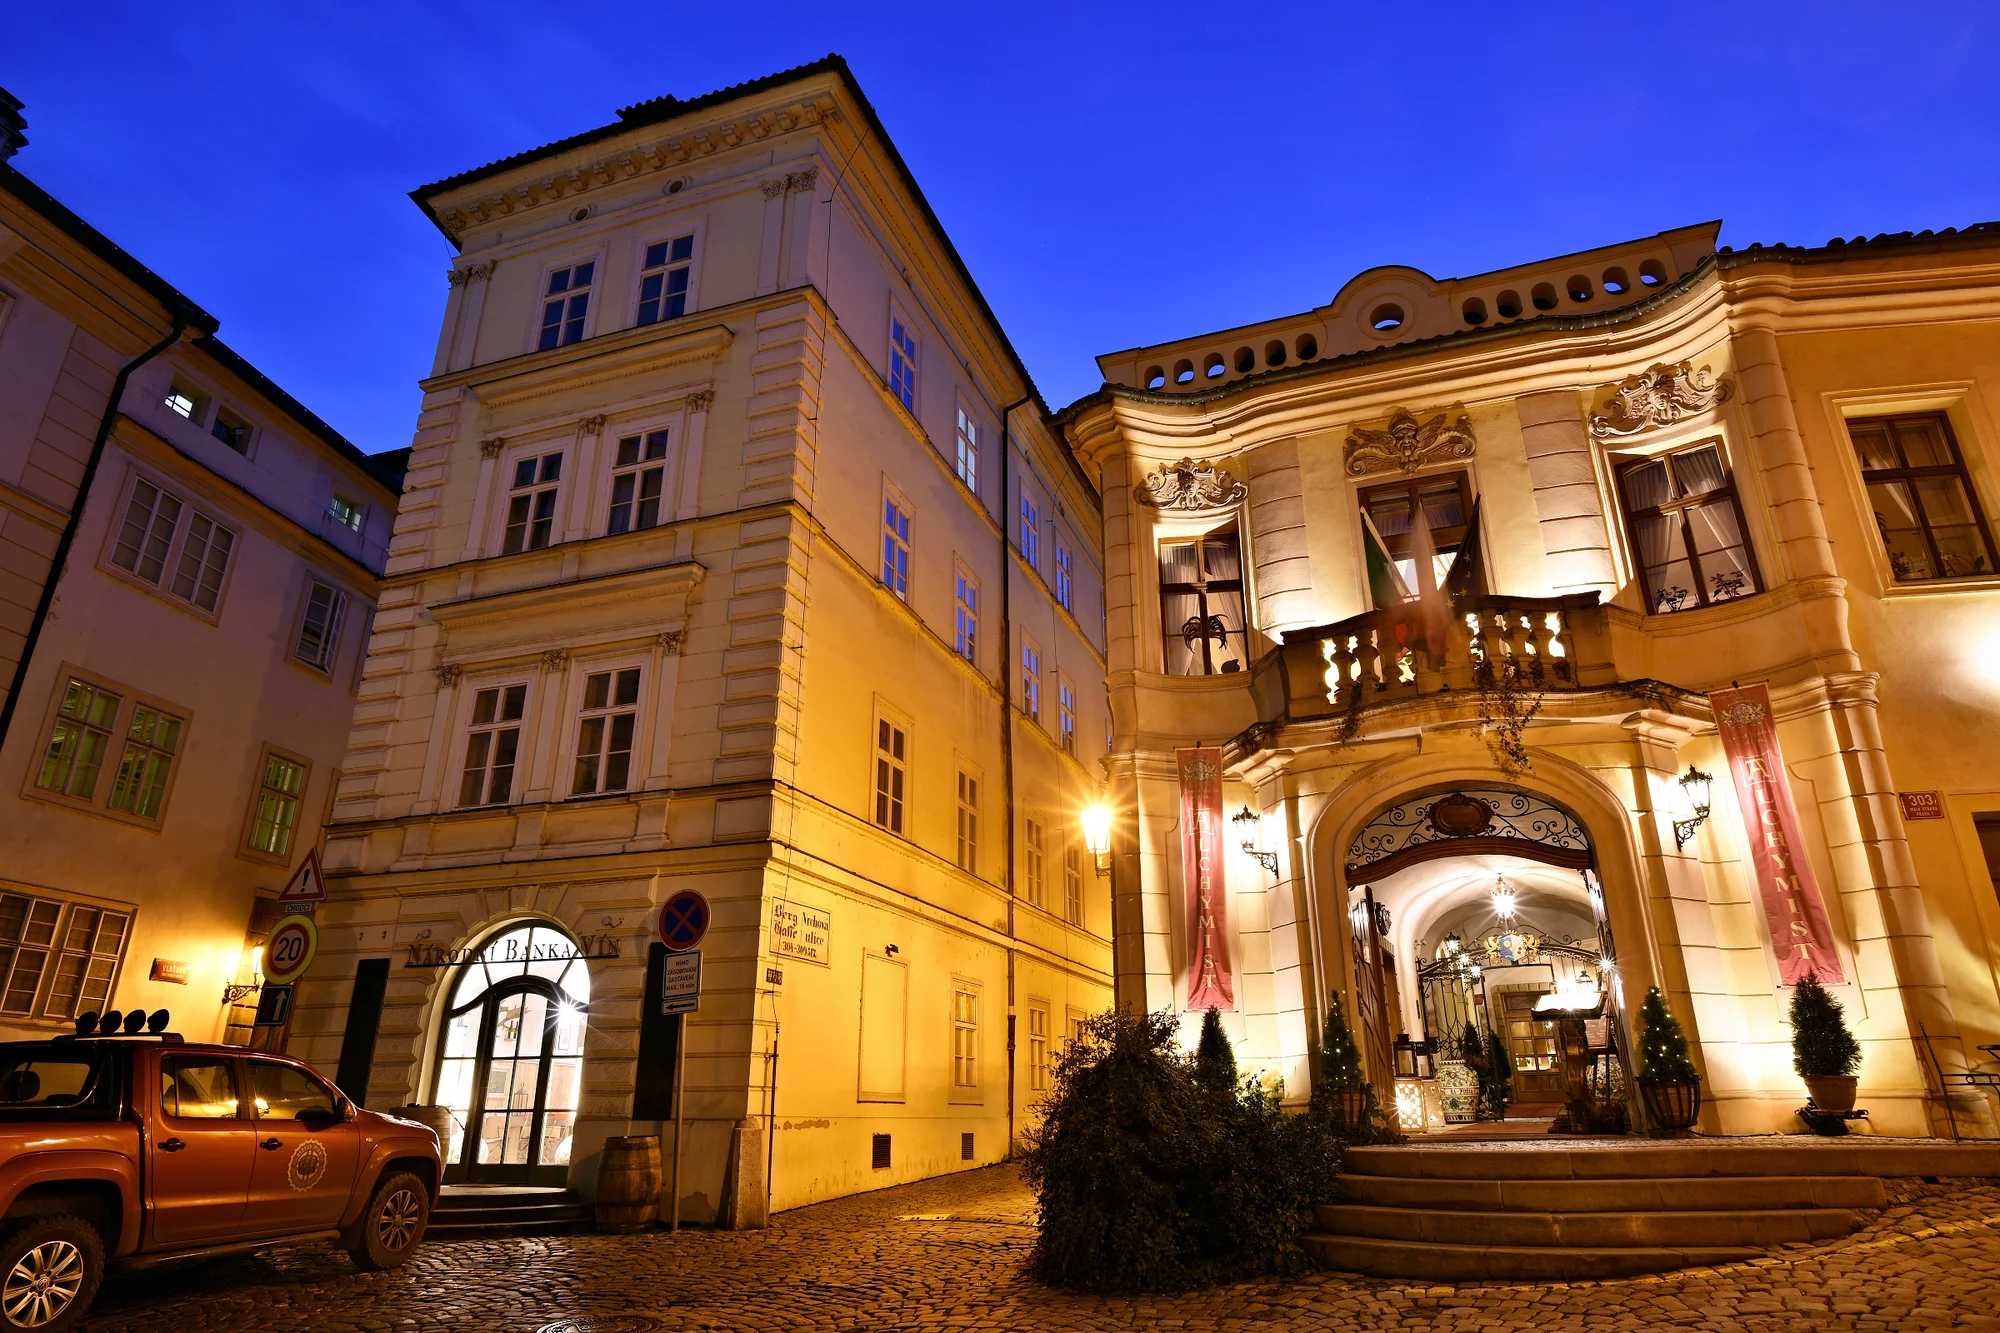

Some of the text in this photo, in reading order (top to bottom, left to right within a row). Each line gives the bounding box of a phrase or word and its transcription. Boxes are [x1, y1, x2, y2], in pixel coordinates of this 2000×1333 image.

[1909, 794, 1933, 806] 303
[1745, 757, 1814, 960] ALCHYMIST
[1195, 811, 1217, 989] ALCHYMIST
[774, 905, 798, 926] Berg
[274, 937, 303, 962] 20
[805, 931, 824, 946] ulice
[506, 939, 571, 961] BANKA
